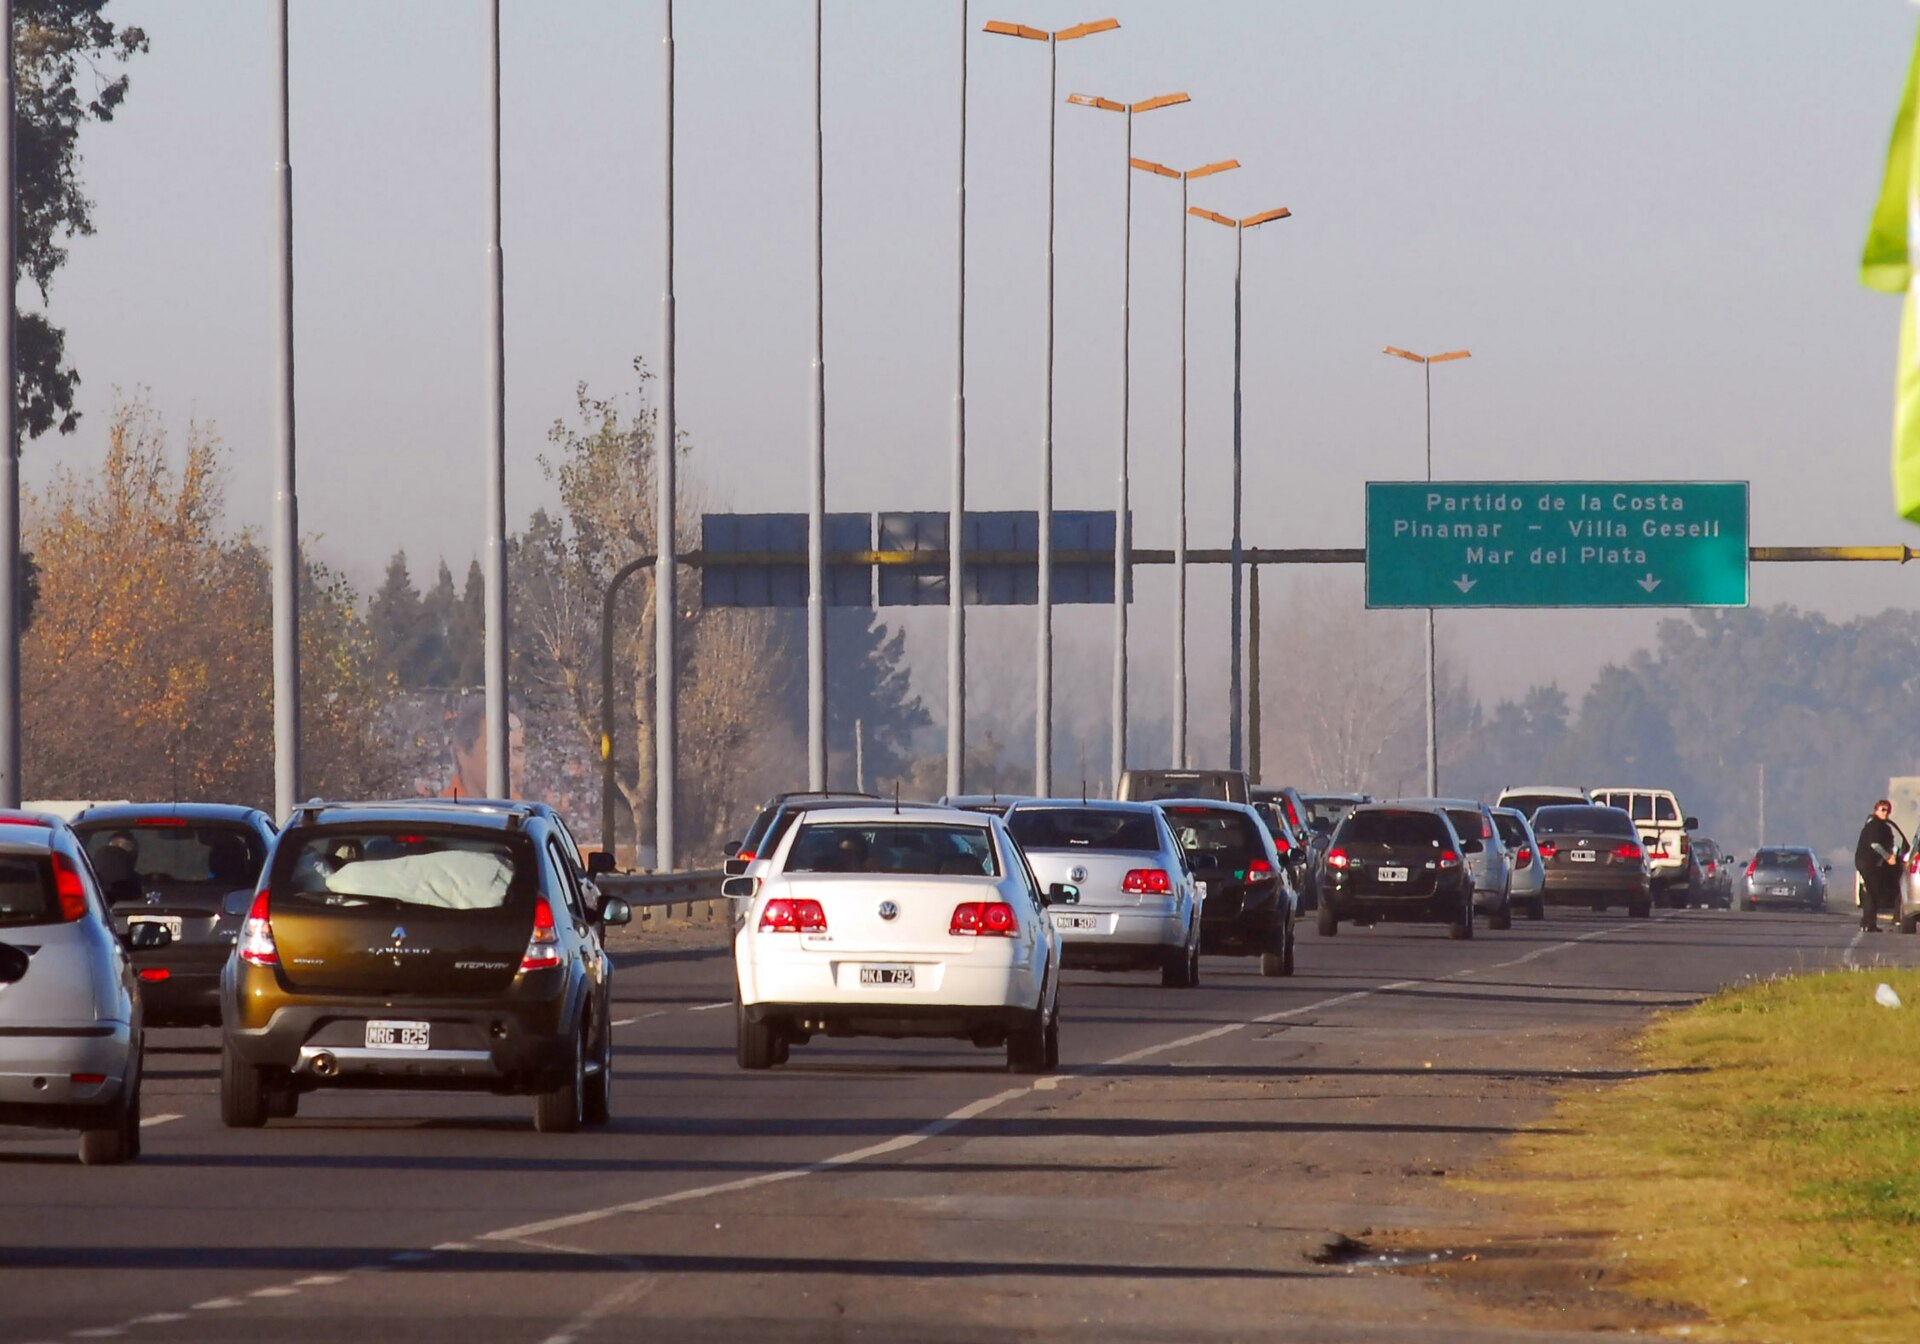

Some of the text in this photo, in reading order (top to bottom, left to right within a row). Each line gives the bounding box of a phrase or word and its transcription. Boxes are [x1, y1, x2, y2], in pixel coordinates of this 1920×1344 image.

[1427, 493, 1684, 511] Partido de la Costa
[1394, 520, 1502, 538] Pinamar
[1568, 520, 1627, 537] Villa
[1642, 520, 1719, 537] Gesell
[1466, 547, 1646, 564] Mar del Plata
[454, 961, 510, 970] STEPWAY
[890, 969, 912, 984] 792
[401, 1029, 428, 1045] 825
